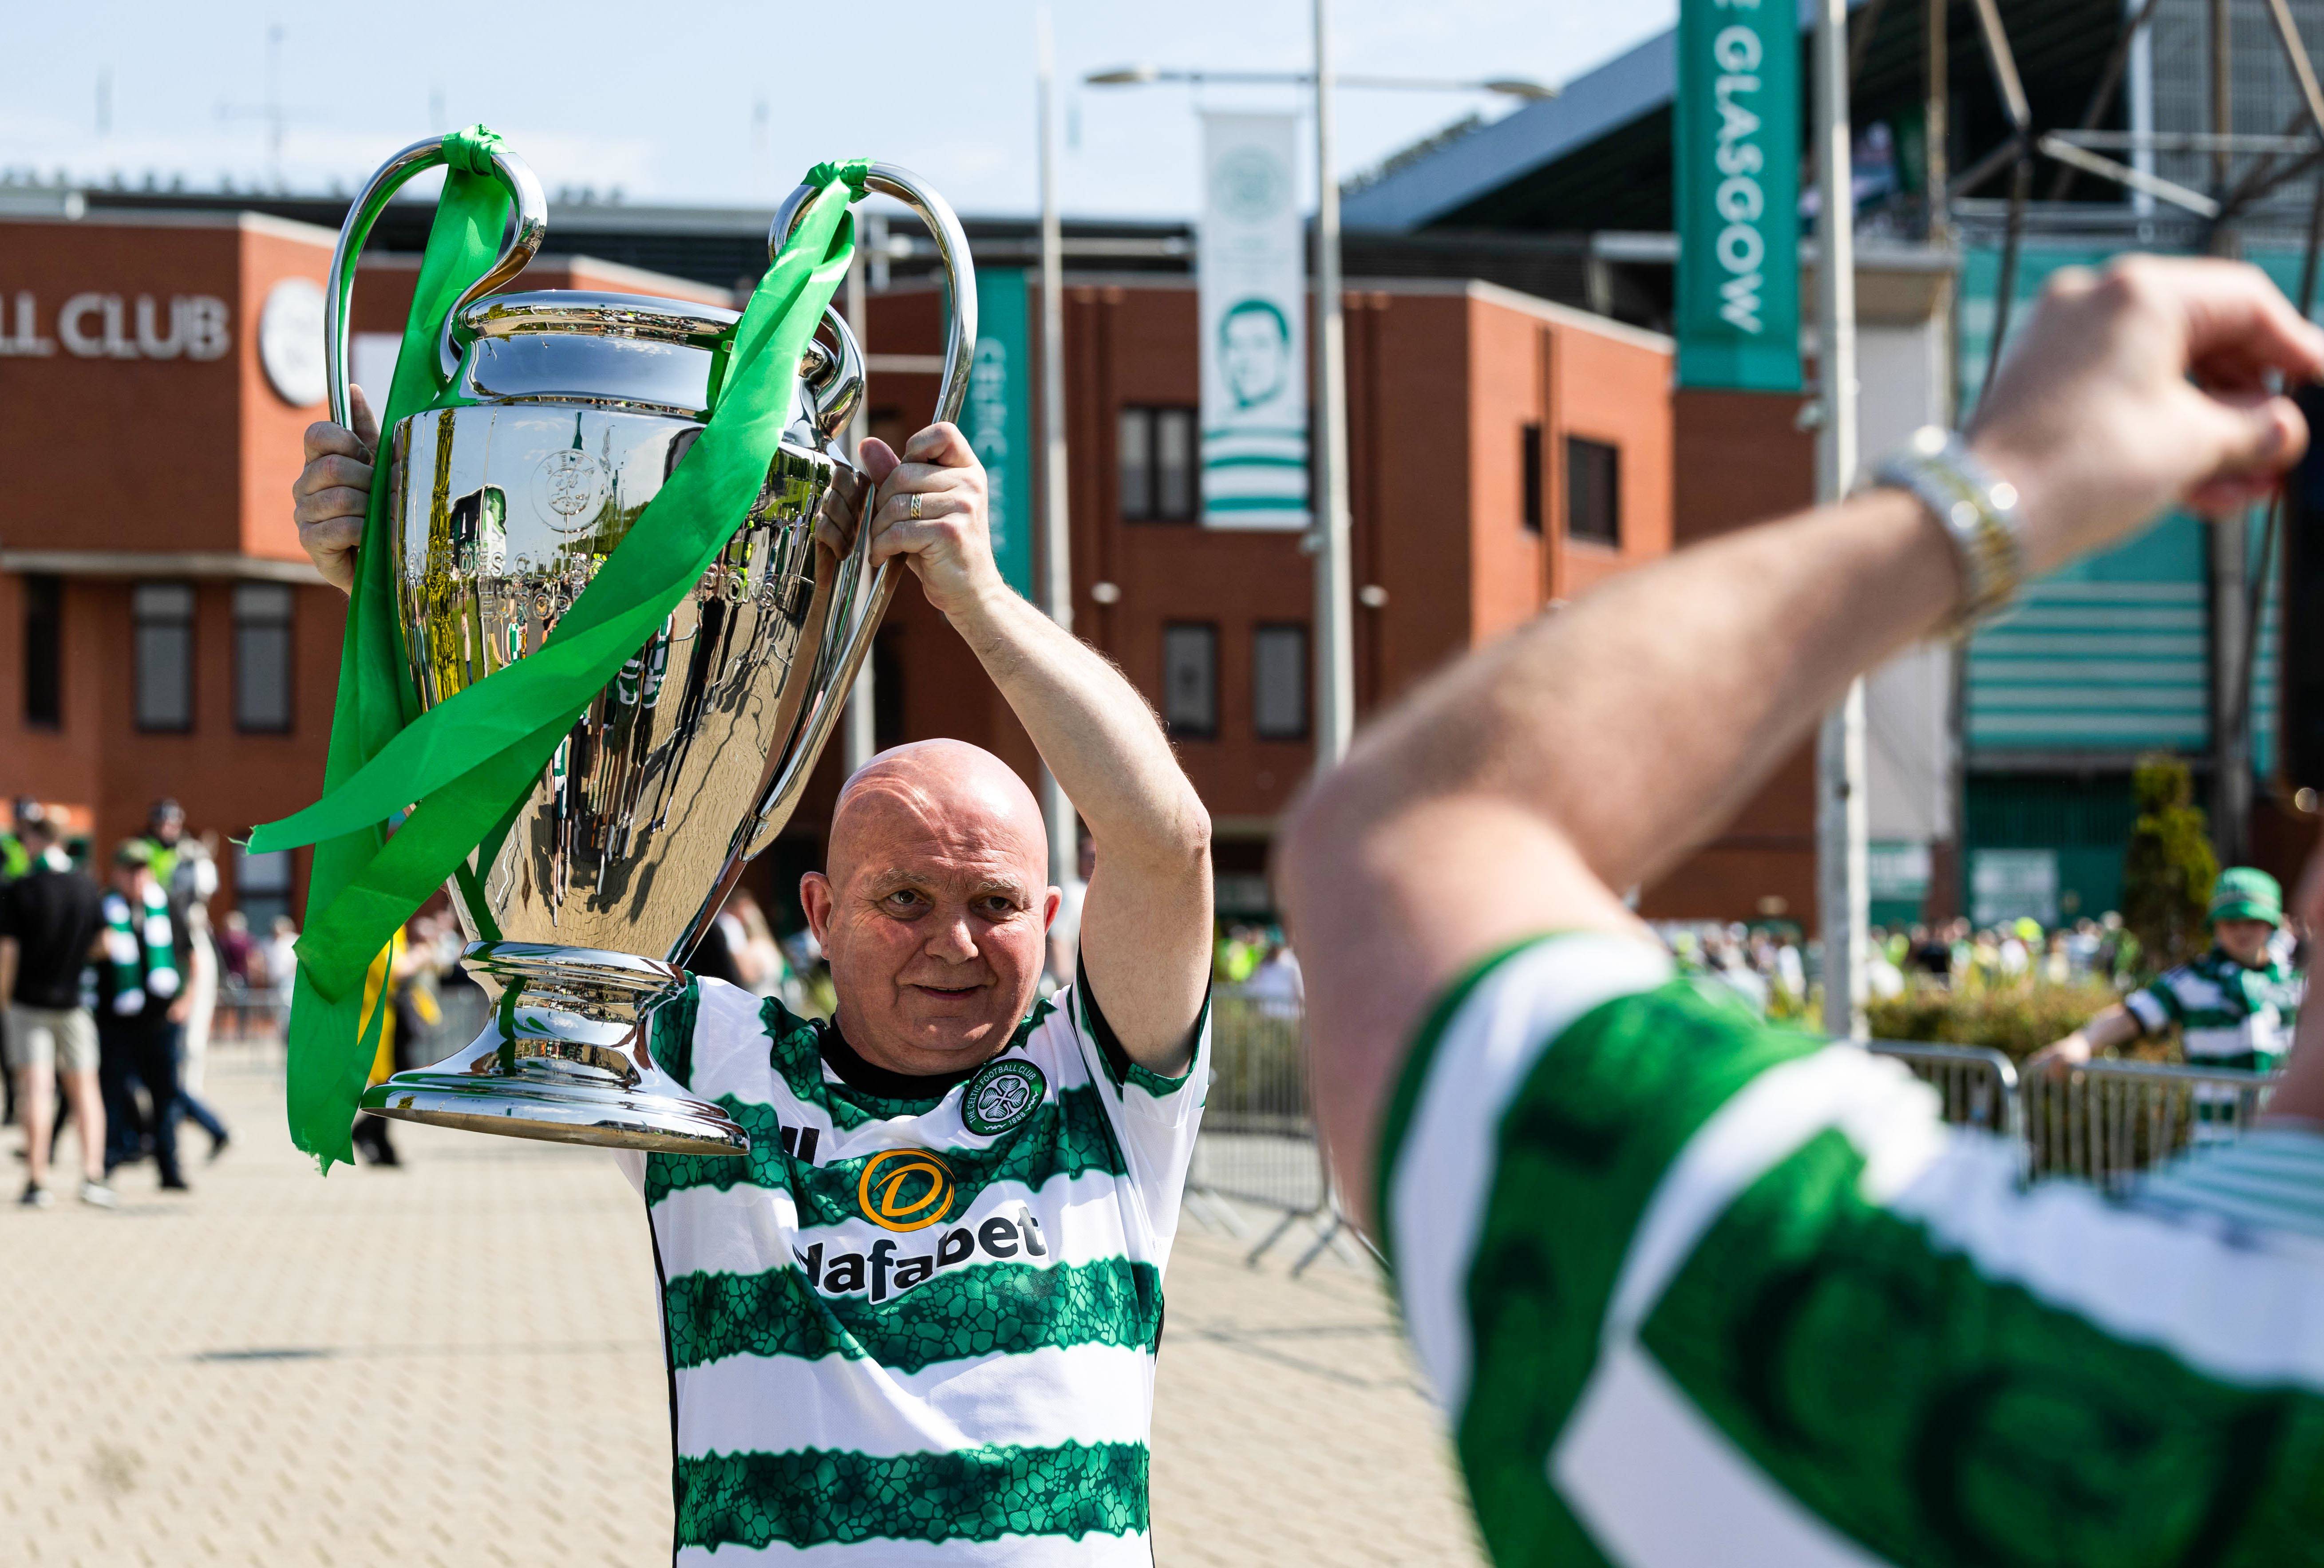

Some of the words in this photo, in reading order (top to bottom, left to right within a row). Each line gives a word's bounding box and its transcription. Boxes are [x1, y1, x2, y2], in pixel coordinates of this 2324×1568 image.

[1714, 25, 1764, 334] GLASGOW
[58, 291, 230, 360] CLUB
[405, 551, 454, 577] OUPE
[980, 1065, 1017, 1085] FOOTBALL
[1018, 1066, 1036, 1080] CLUB
[968, 1085, 981, 1110] CELTIC
[968, 1110, 976, 1124] THE
[1008, 1111, 1026, 1126] 1888
